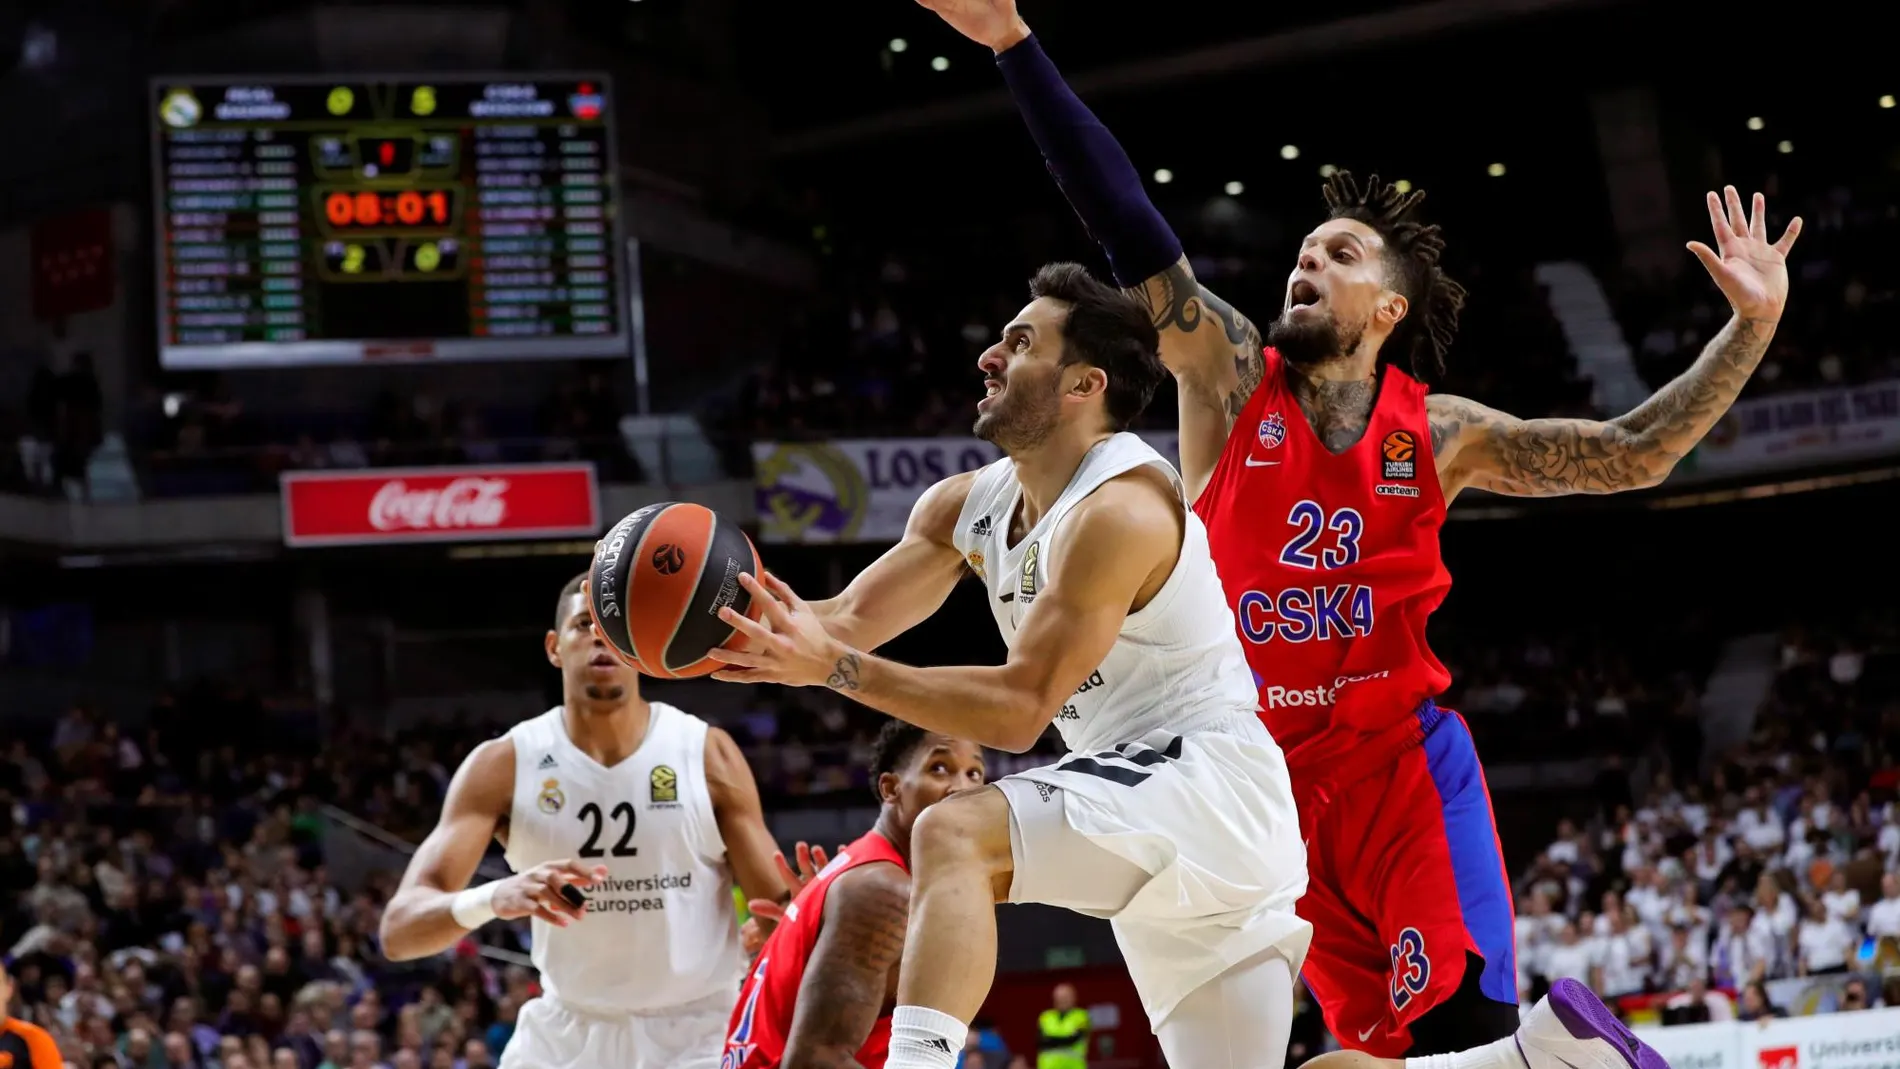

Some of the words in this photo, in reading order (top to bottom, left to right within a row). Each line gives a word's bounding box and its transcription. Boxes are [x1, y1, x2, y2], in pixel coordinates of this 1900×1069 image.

[326, 191, 448, 225] 08:01
[1261, 423, 1283, 437] CSKA
[866, 447, 944, 489] LOS
[368, 477, 512, 531] Coca-Cola
[600, 507, 658, 619] SPALDING
[1279, 499, 1364, 570] 23
[1239, 583, 1374, 644] CSKA
[576, 801, 638, 858] 22
[1390, 927, 1431, 1012] 23
